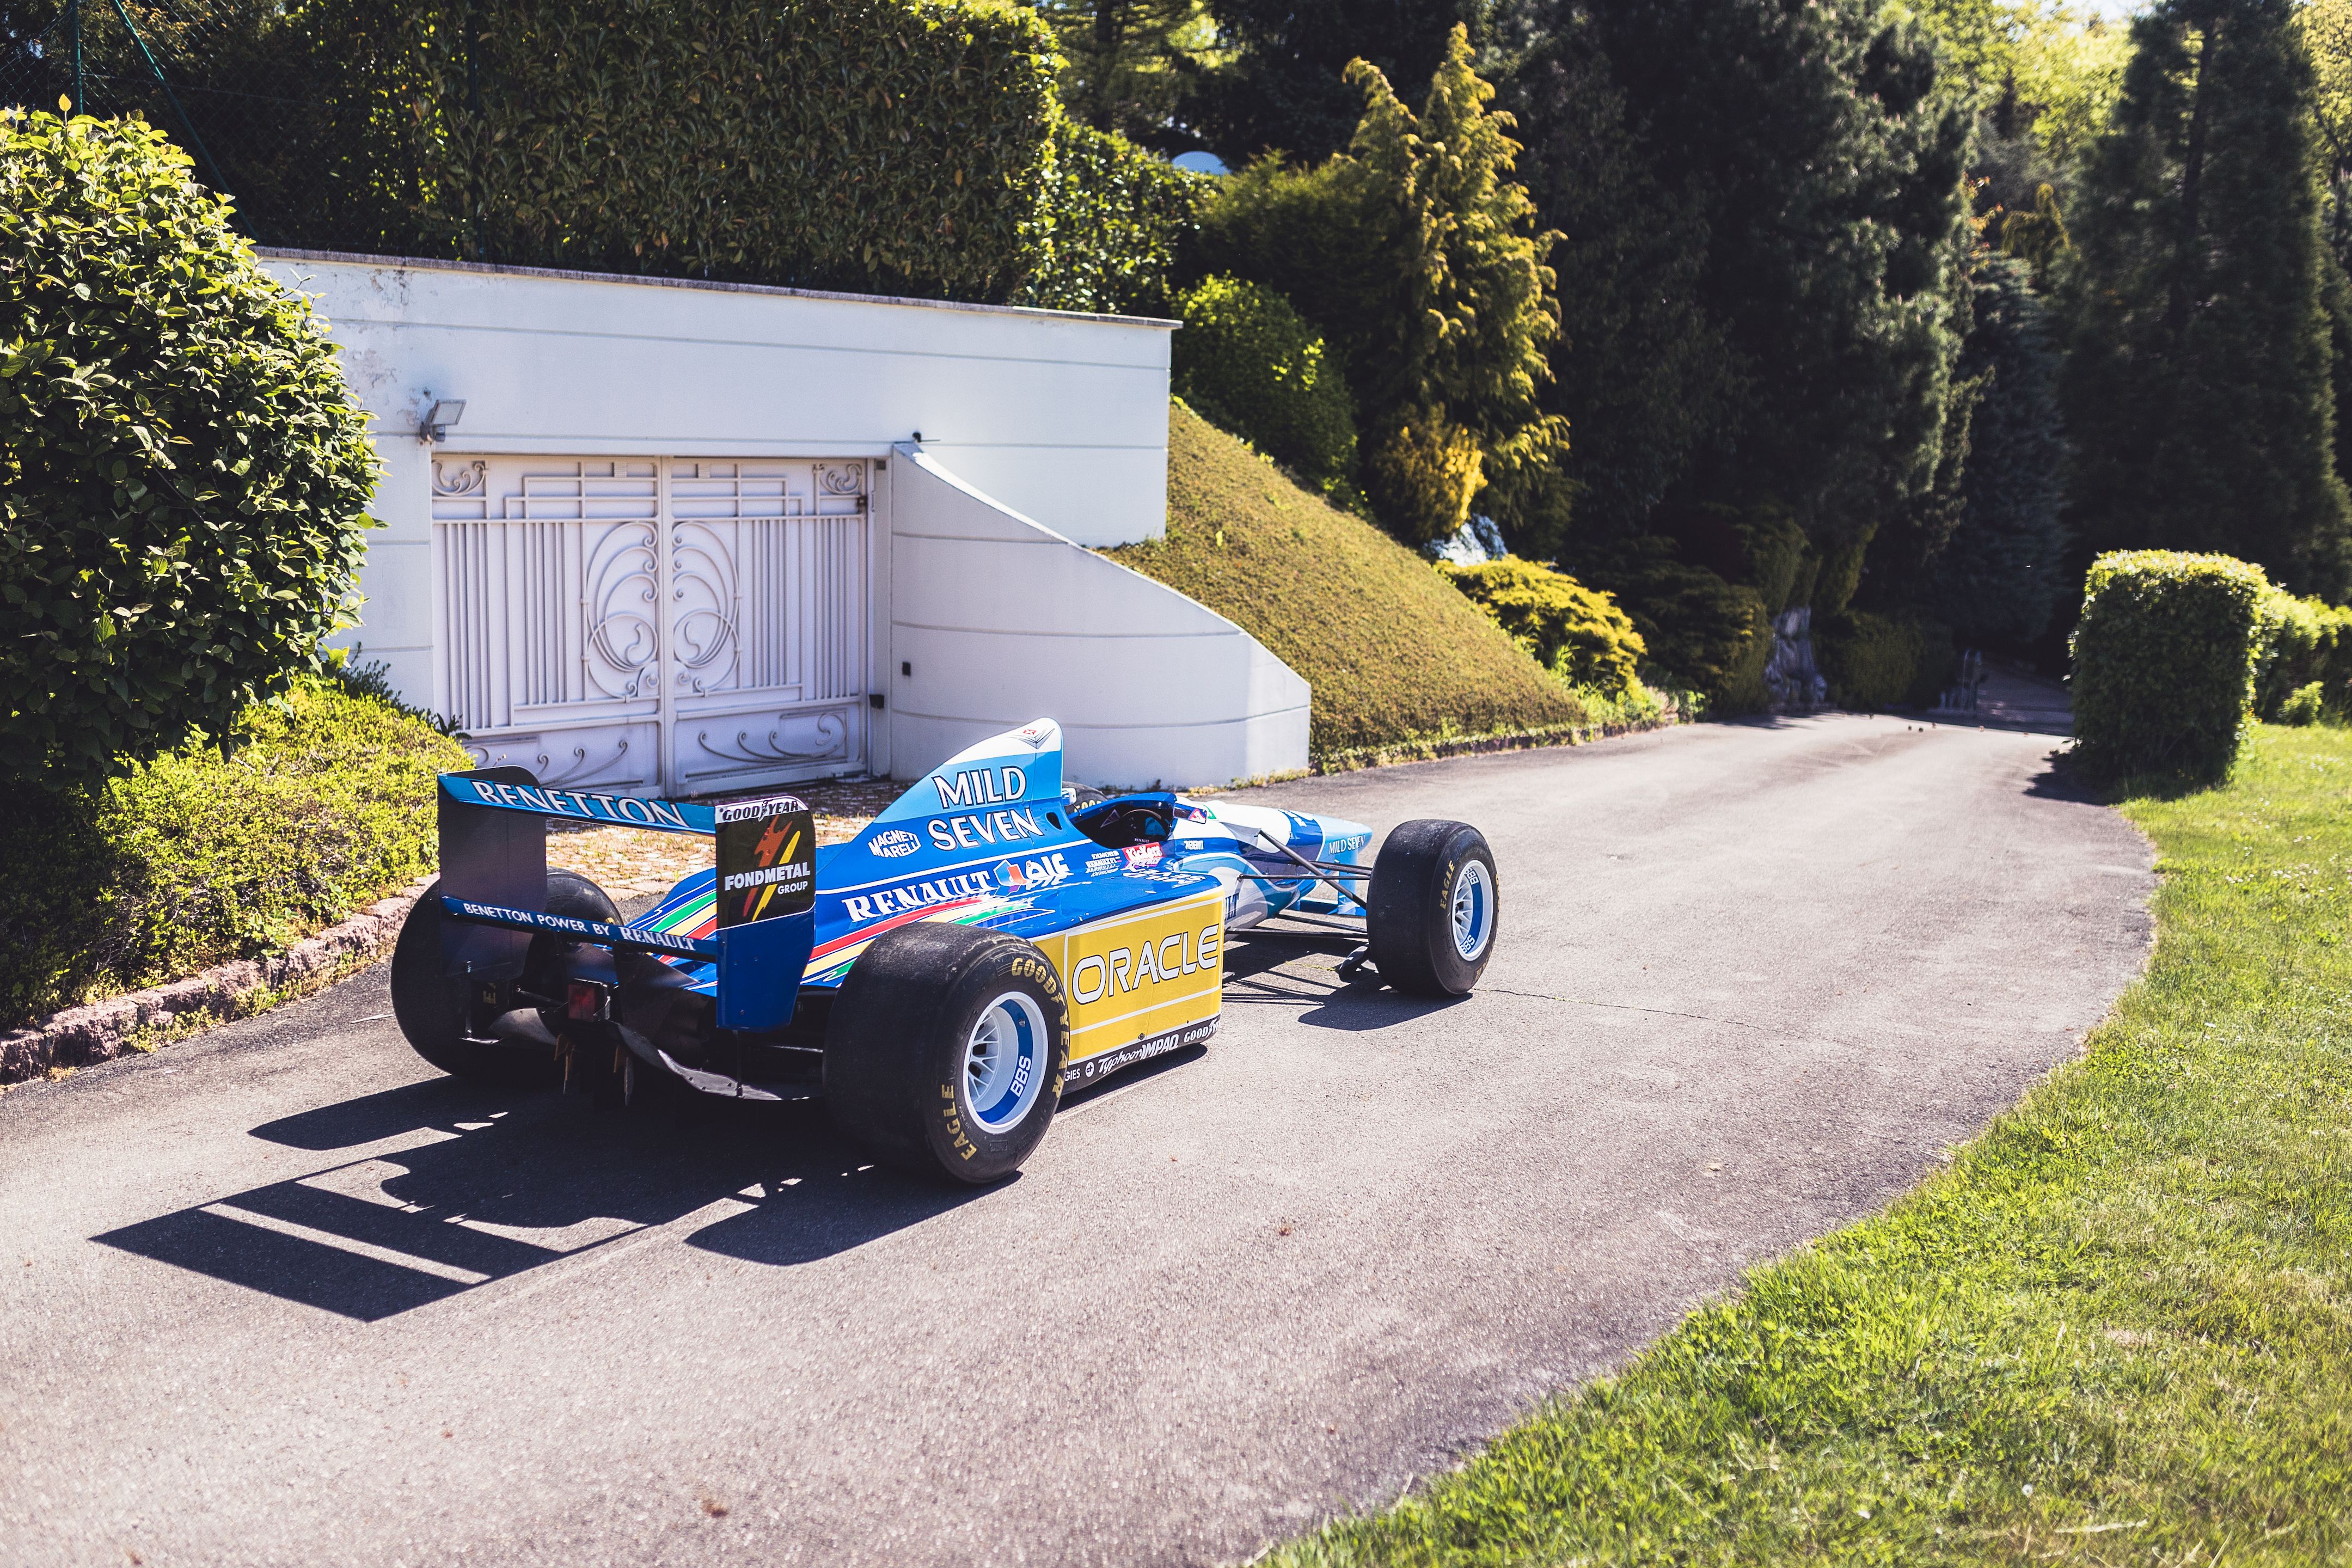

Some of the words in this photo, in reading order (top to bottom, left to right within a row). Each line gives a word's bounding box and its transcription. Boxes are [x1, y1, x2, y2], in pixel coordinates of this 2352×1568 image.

[471, 781, 690, 828] BENETTON
[931, 765, 1027, 810] MILD
[868, 830, 919, 850] MAGNETI
[869, 841, 921, 857] MARELLI
[927, 807, 1044, 852] SEVEN
[1328, 839, 1346, 855] MILD
[1347, 835, 1365, 851] SEVEN
[725, 862, 811, 891] FONDMETAL
[777, 881, 808, 895] GROUP
[842, 870, 990, 923] RENAULT
[1440, 860, 1455, 910] EAGLE
[463, 903, 533, 923] BENETTON
[538, 915, 587, 933] POWER
[593, 924, 610, 936] BY
[618, 927, 696, 951] RENAULT
[1460, 934, 1475, 954] BBS
[1072, 924, 1220, 1006] ORACLE
[1010, 1055, 1031, 1098] BBS
[1098, 1049, 1142, 1074] Typhoon
[941, 1084, 977, 1161] EAGLE
